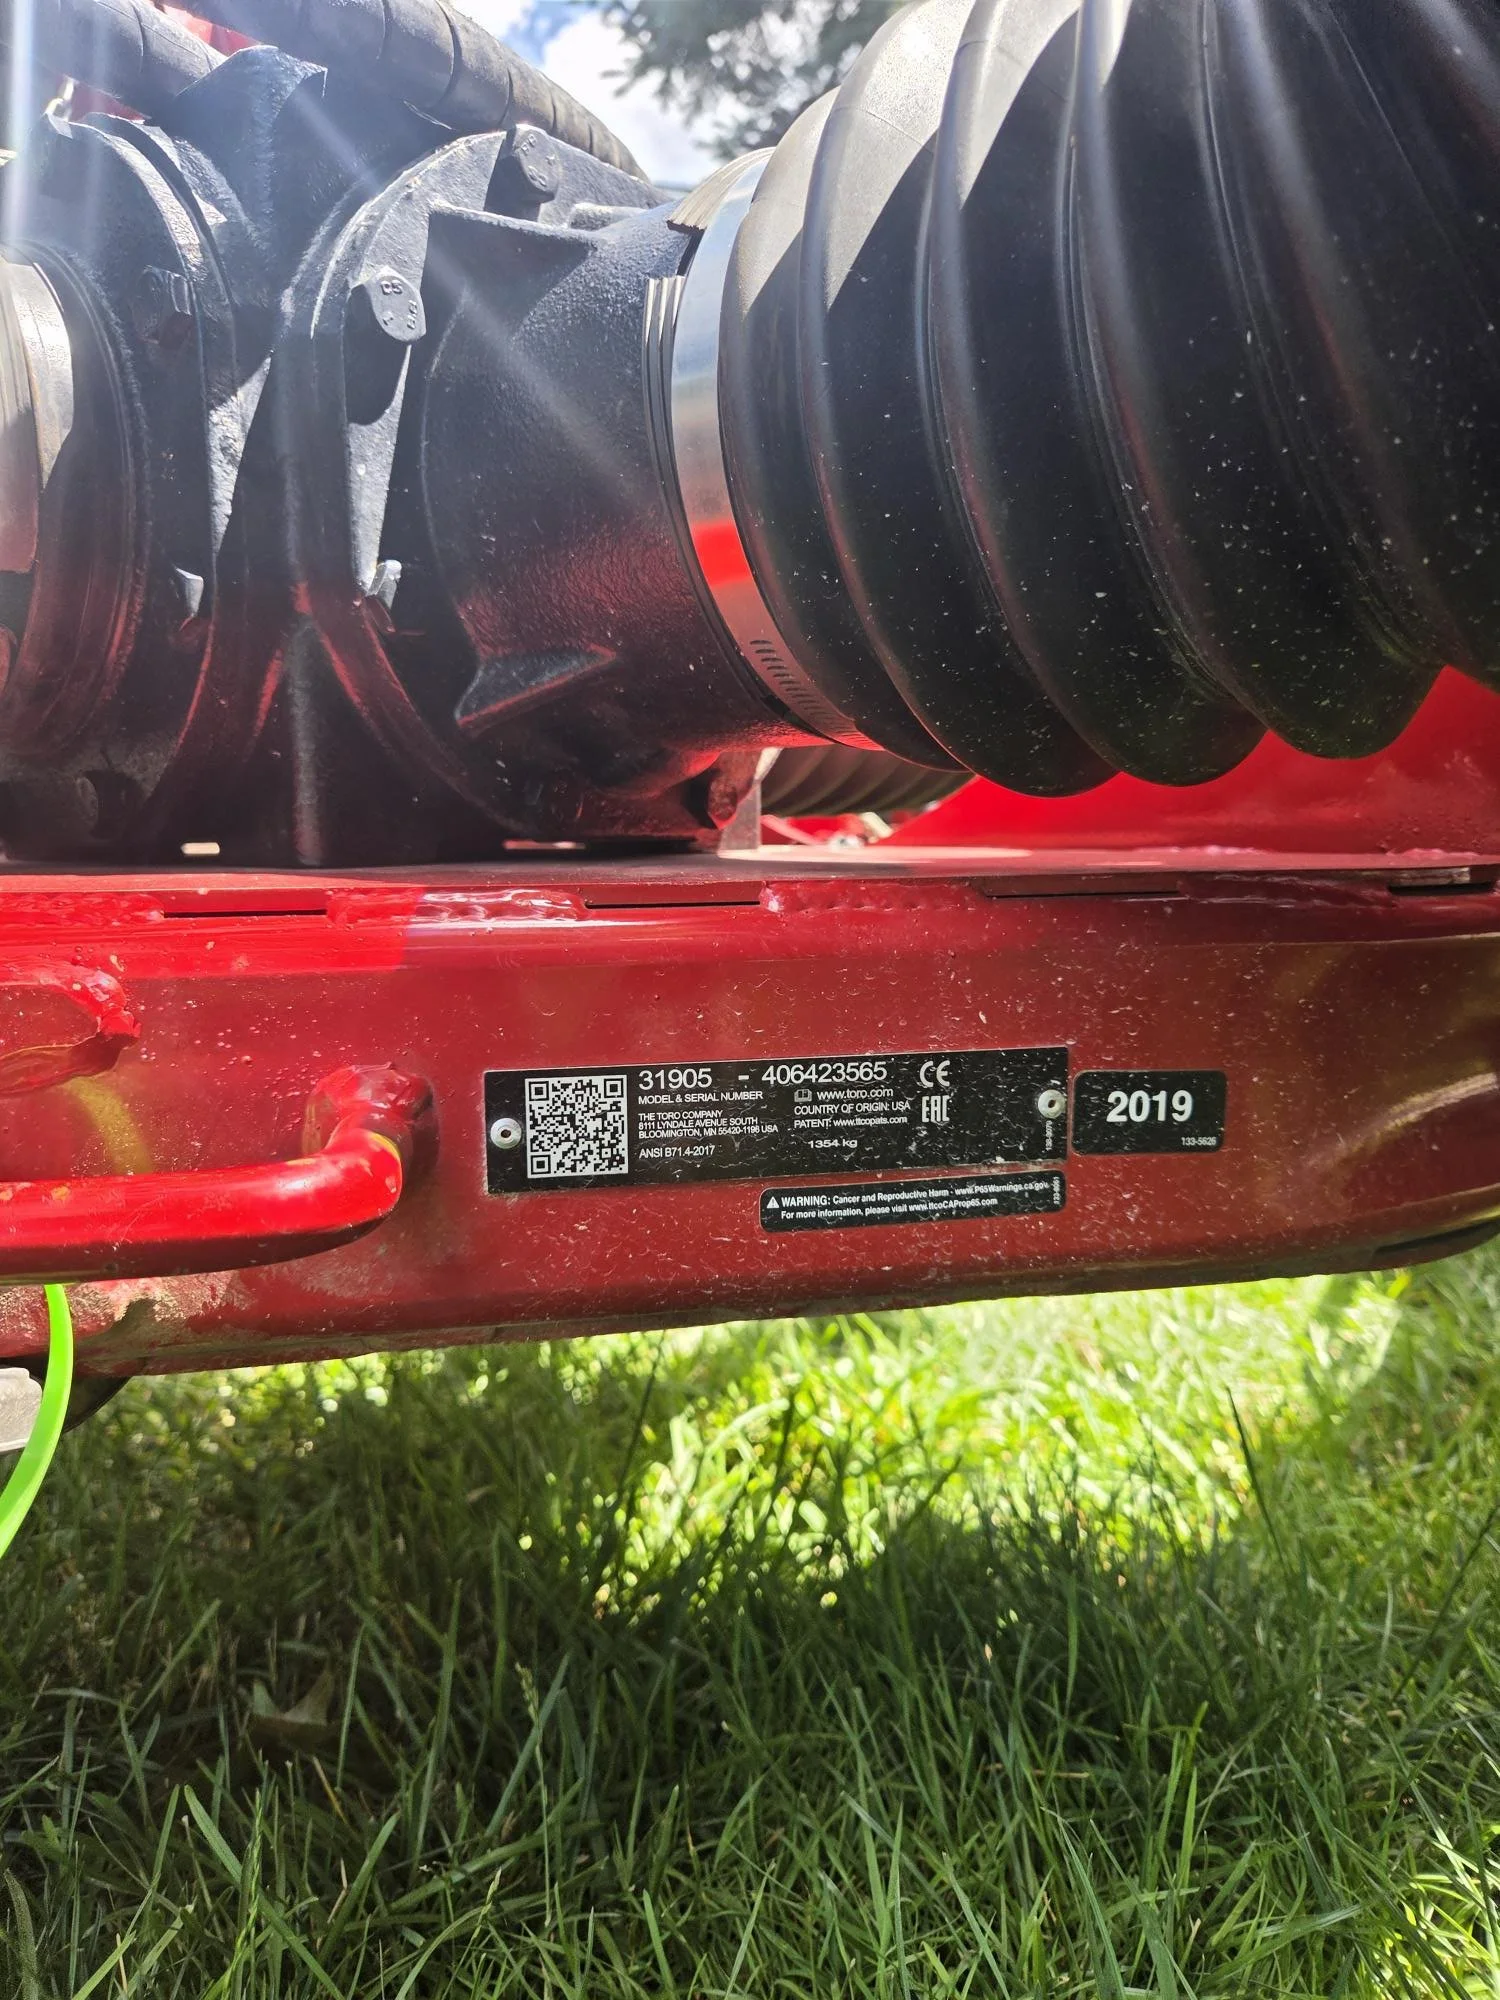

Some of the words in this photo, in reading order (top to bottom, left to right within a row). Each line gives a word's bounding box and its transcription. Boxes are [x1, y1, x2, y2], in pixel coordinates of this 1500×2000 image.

[638, 1067, 713, 1091] 31905
[761, 1061, 888, 1086] 406423565
[638, 1095, 674, 1105] MODEL
[675, 1093, 683, 1103] &
[684, 1092, 719, 1103] SERIAL
[720, 1090, 764, 1101] NUMBER
[816, 1088, 894, 1100] www.toro.com
[794, 1104, 840, 1116] COUNTRY
[841, 1104, 854, 1114] OF
[855, 1102, 890, 1113] ORIGIN:
[892, 1100, 911, 1112] USA
[1106, 1089, 1194, 1123] 2019
[638, 1112, 656, 1121] THE
[656, 1111, 681, 1120] TORO
[681, 1109, 723, 1119] COMPANY
[638, 1122, 655, 1131] 8111
[657, 1120, 694, 1130] LYNDALE
[694, 1118, 728, 1128] AVENUE
[729, 1116, 758, 1126] SOUTH
[794, 1118, 832, 1129] PATENT:
[638, 1129, 702, 1139] BLOOMINGTON,
[703, 1128, 717, 1137] MN
[761, 1124, 779, 1134] USA
[809, 1139, 841, 1149] 1354
[842, 1138, 858, 1149] kg
[638, 1148, 663, 1159] ANSI
[664, 1144, 716, 1157] B71.4-2017
[781, 1195, 831, 1207] WARNING:
[833, 1195, 860, 1204] Cancer
[861, 1193, 877, 1203] and
[877, 1190, 927, 1202] Reproductive
[928, 1188, 949, 1197] Harm
[781, 1210, 794, 1219] For
[796, 1210, 816, 1218] more
[865, 1205, 890, 1216] please
[891, 1203, 907, 1213] visit
